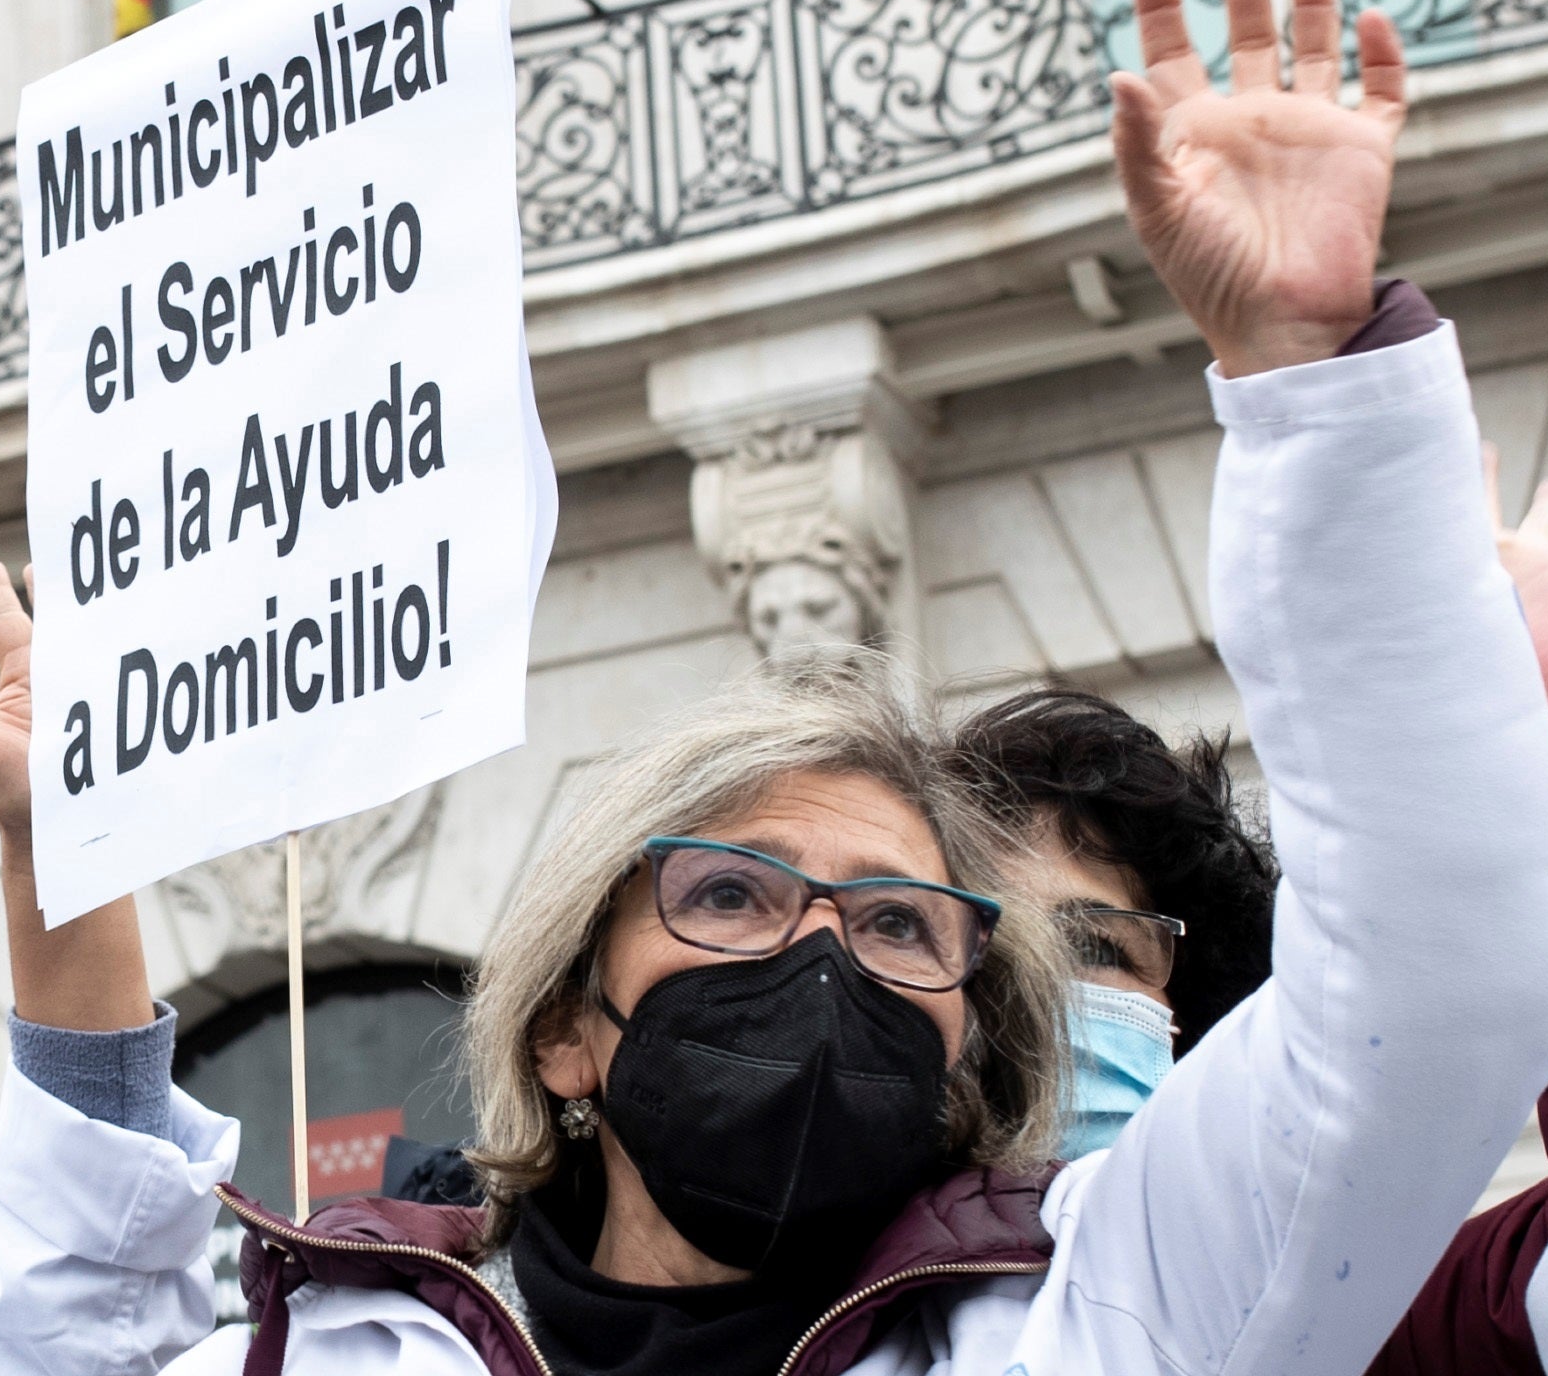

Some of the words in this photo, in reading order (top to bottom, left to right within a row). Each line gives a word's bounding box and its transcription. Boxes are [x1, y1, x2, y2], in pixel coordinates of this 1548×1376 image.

[85, 283, 135, 414] el
[156, 182, 422, 384] Servicio
[70, 478, 141, 606] de
[162, 448, 211, 571] la
[227, 361, 446, 558] Ayuda
[62, 700, 96, 796] a
[116, 538, 452, 776] Domicilio!
